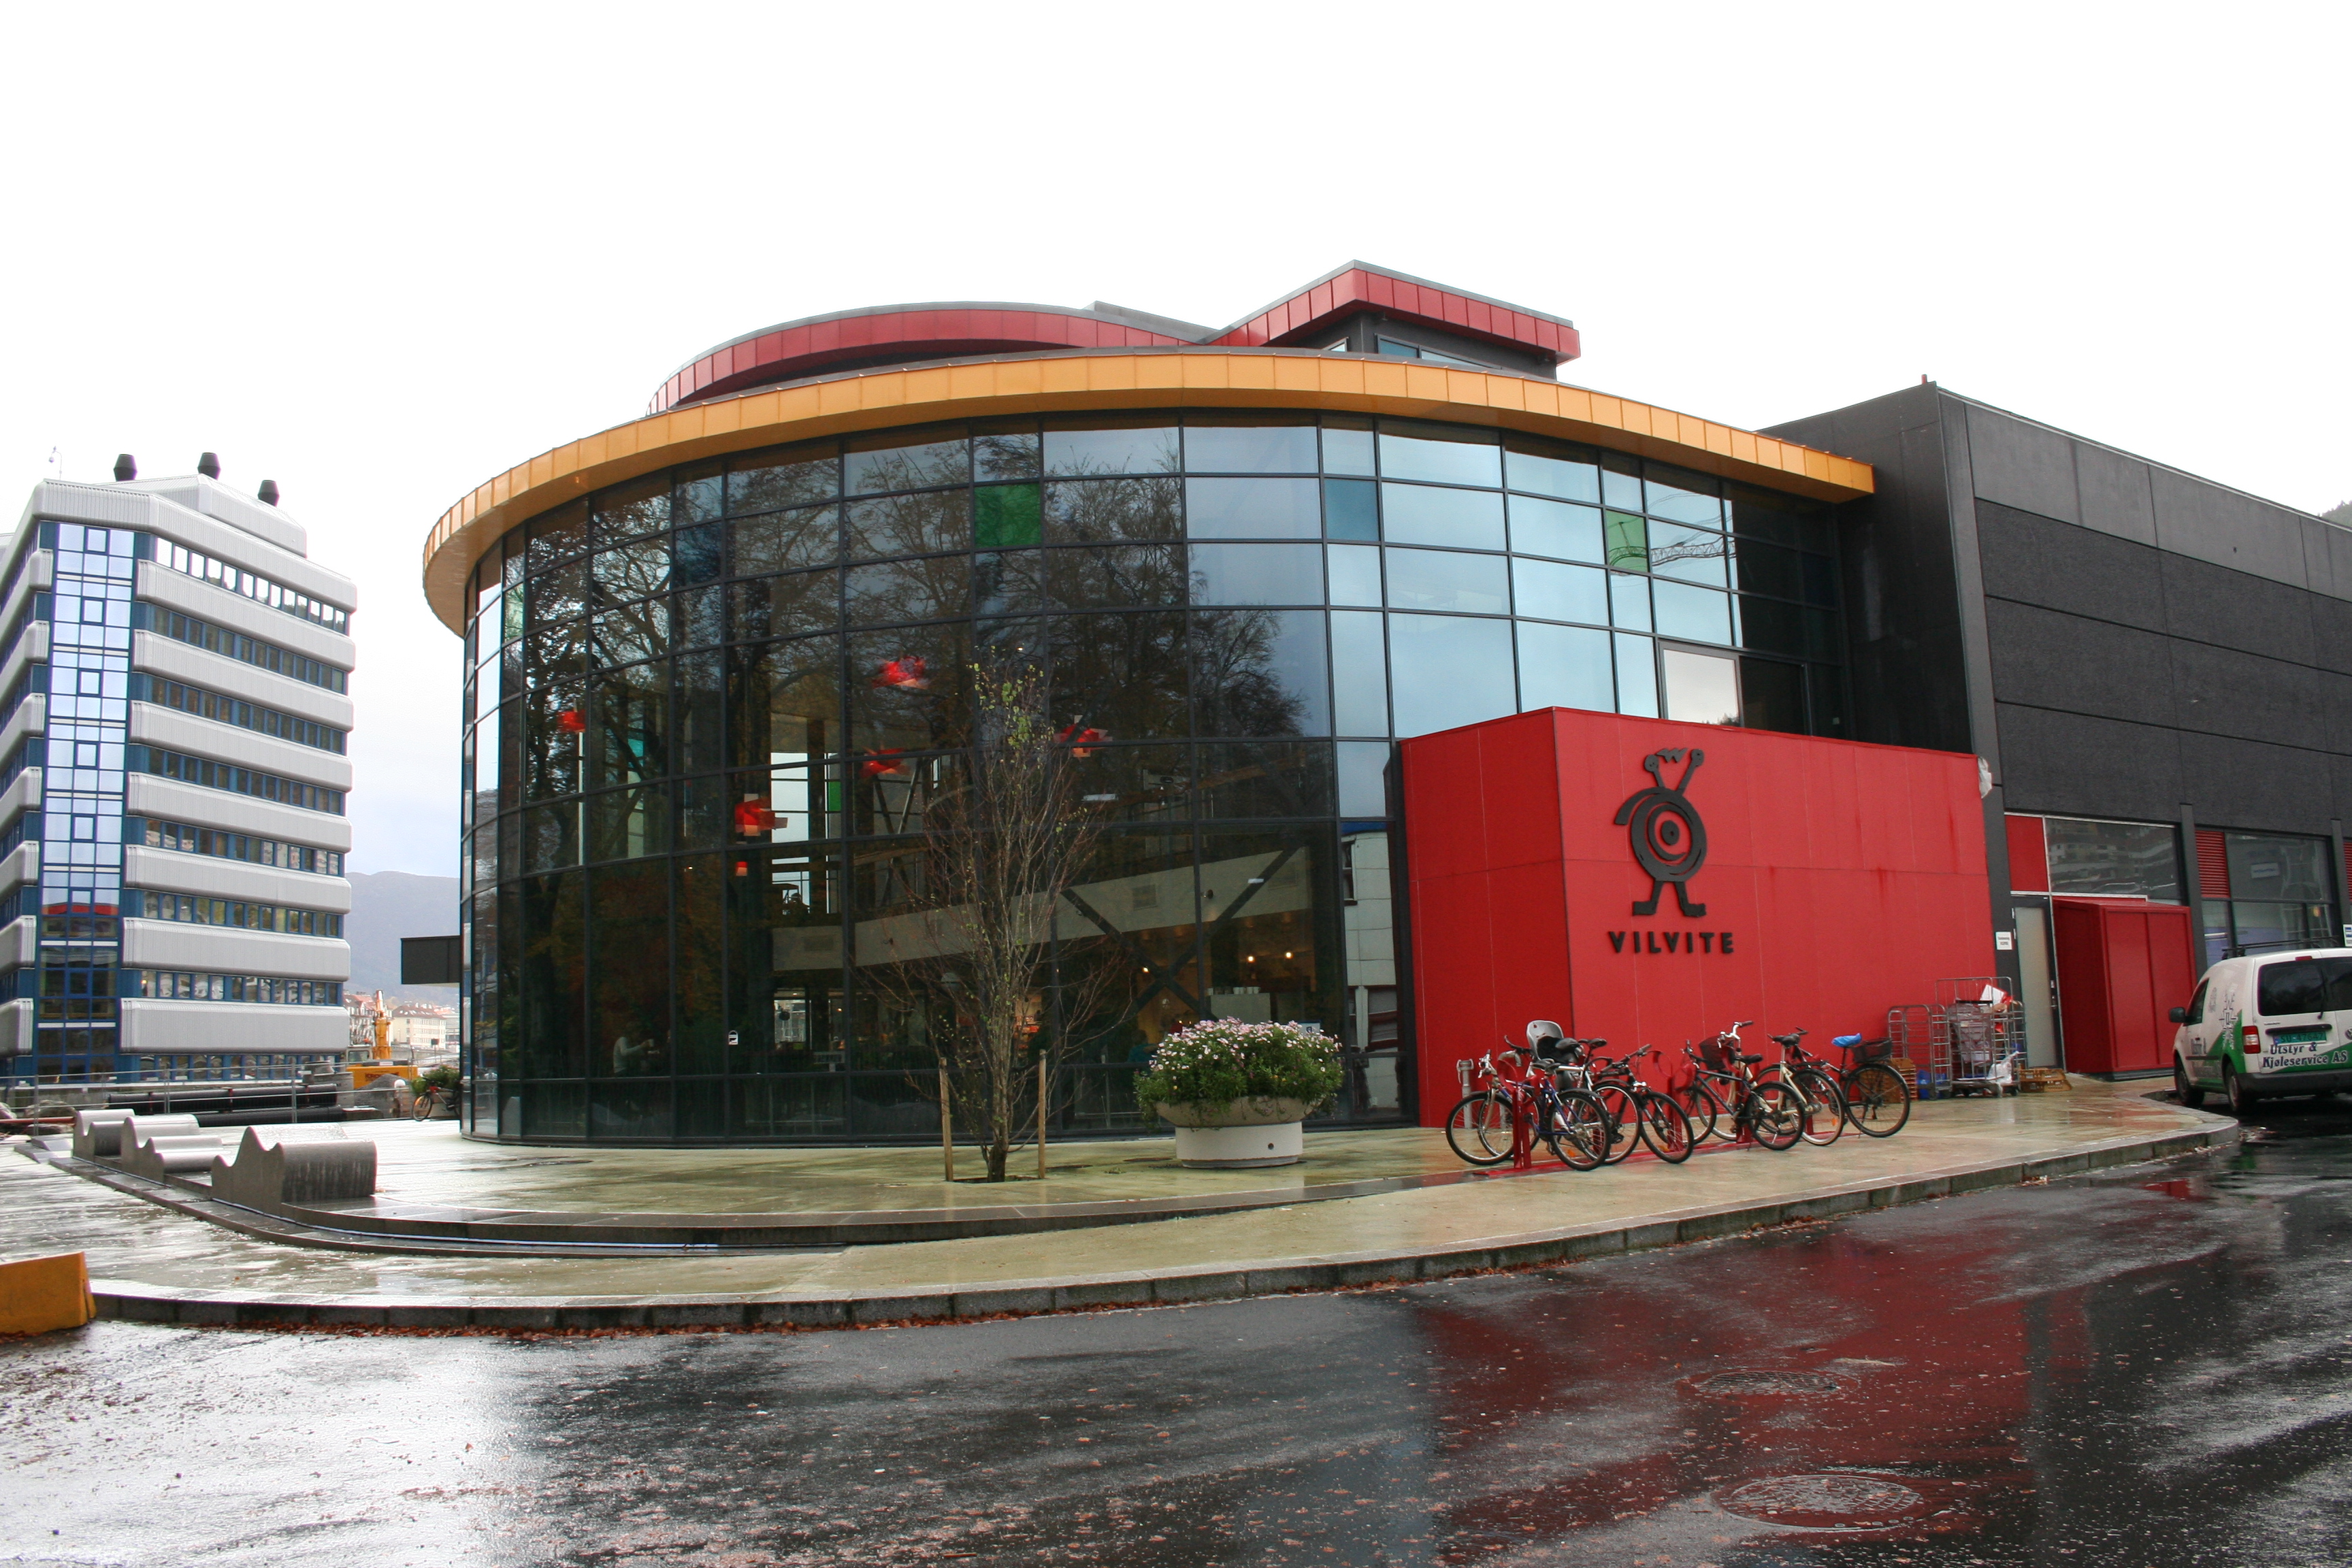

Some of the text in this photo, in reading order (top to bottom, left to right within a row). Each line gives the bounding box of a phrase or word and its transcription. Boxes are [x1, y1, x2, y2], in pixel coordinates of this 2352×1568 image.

[1608, 930, 1734, 954] VILVITE
[2270, 1042, 2317, 1055] Utstyr &
[2263, 1051, 2348, 1068] Kjøleservice AS
